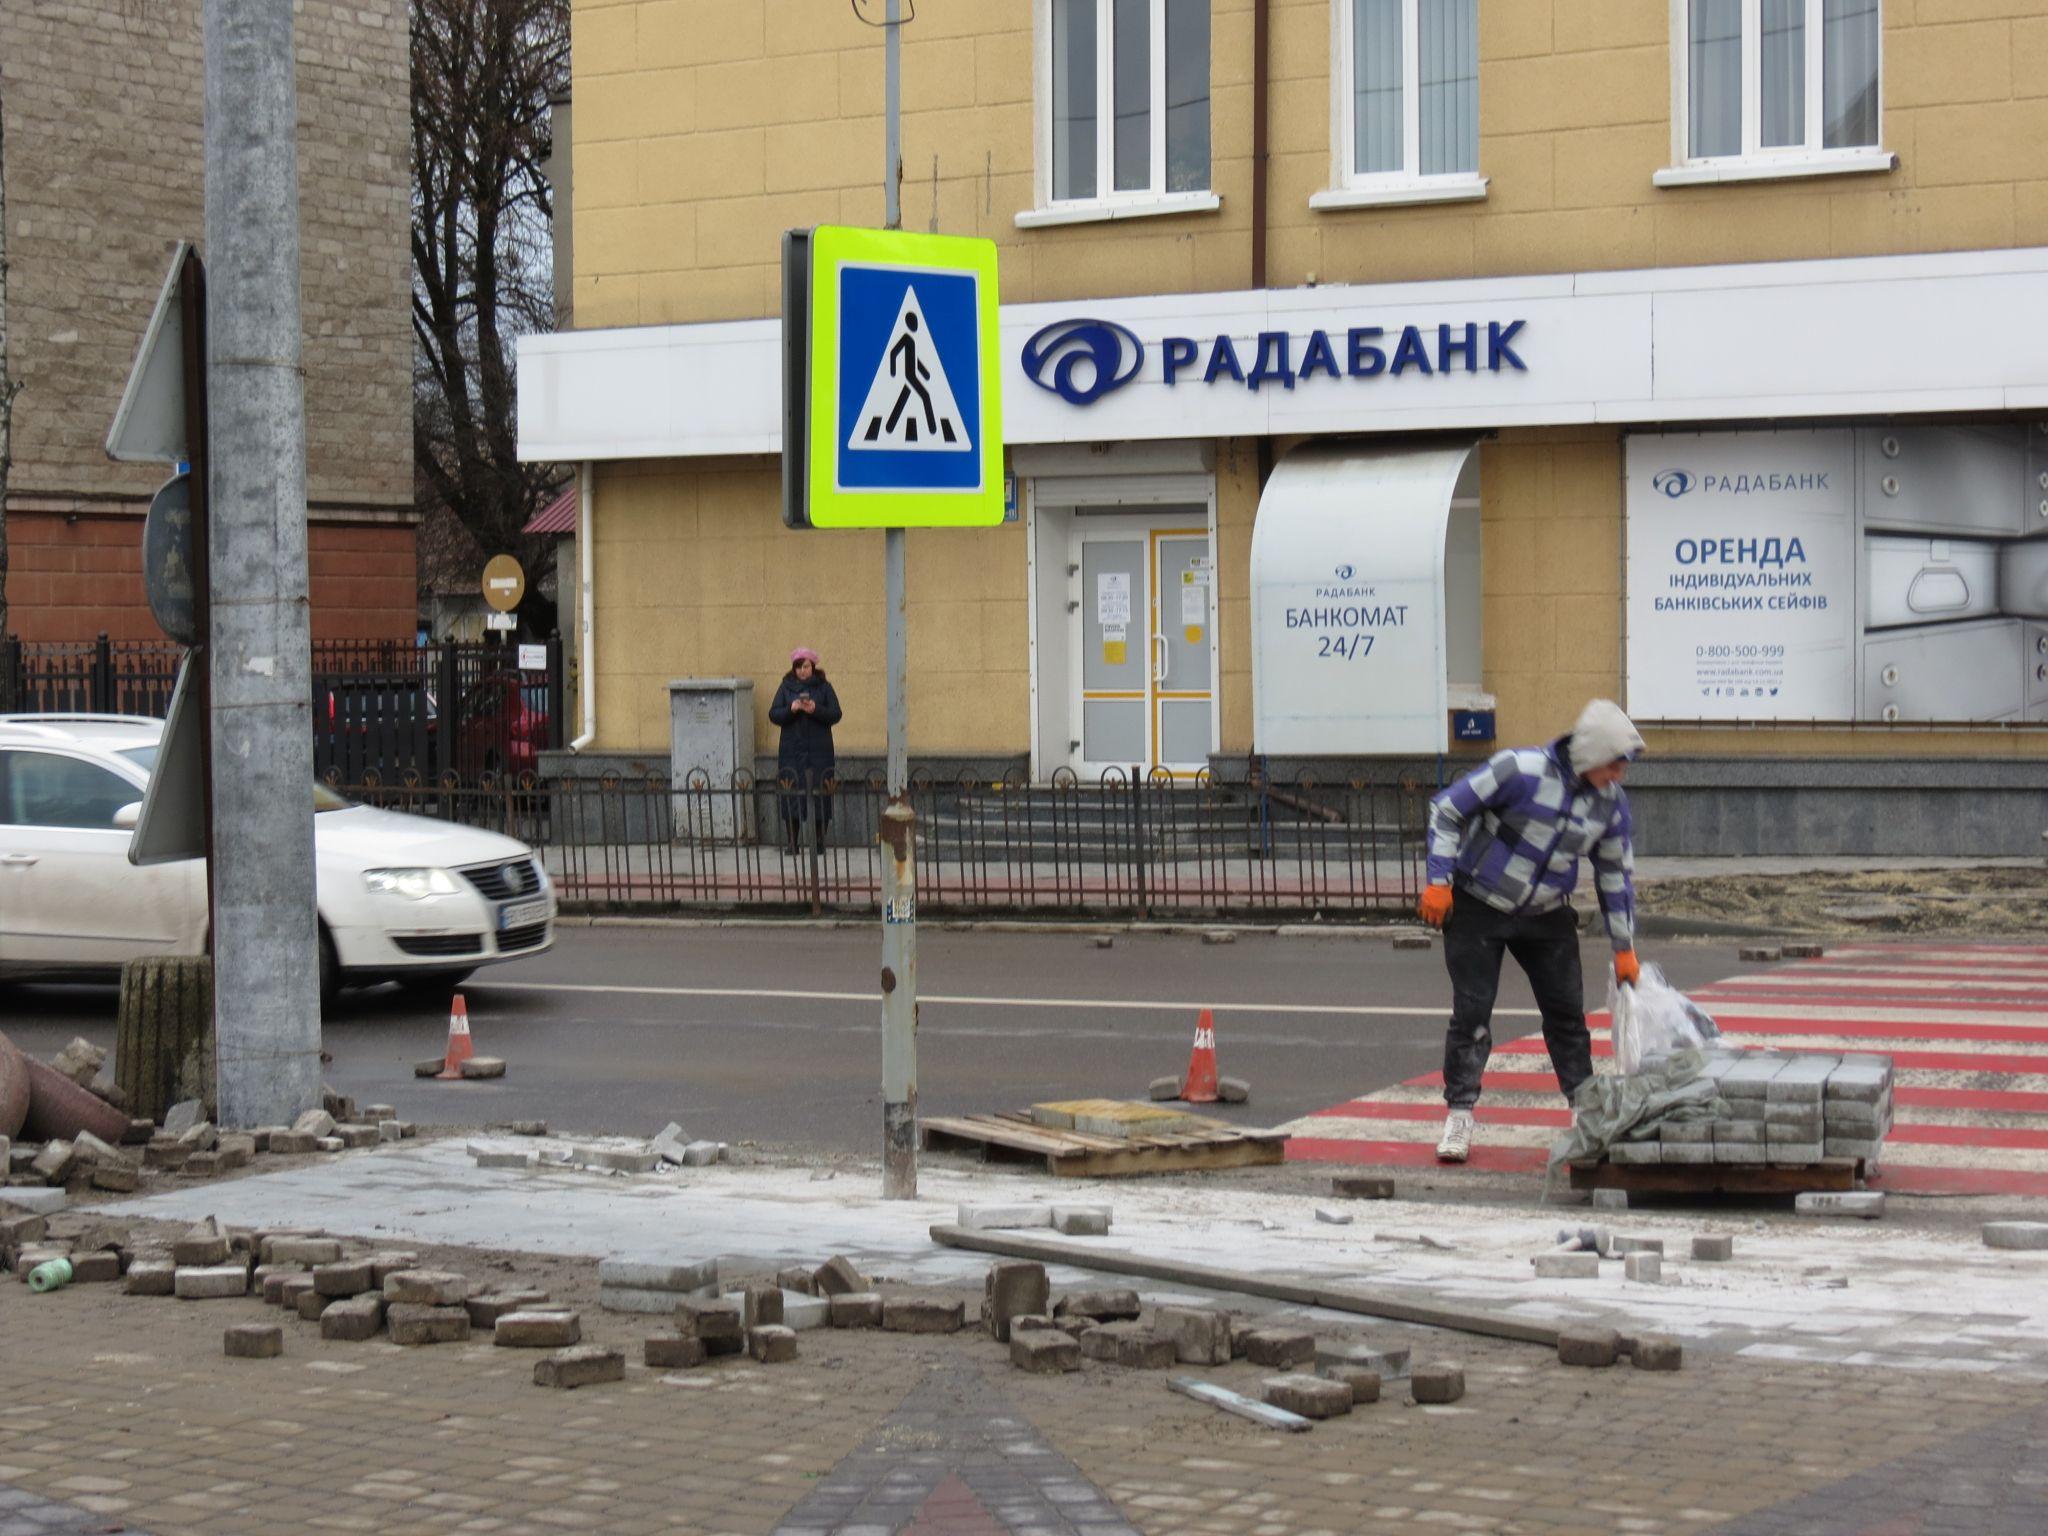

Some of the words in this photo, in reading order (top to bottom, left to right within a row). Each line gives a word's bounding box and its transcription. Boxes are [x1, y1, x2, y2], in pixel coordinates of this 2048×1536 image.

[1162, 320, 1527, 390] РАДАБАНК
[1704, 472, 1829, 494] РАДАБАНК
[1675, 537, 1806, 569] ОРЕНДА
[1669, 572, 1812, 590] ІНДИВІДУАЛЬНИХ
[1316, 587, 1376, 598] РАДАБАНК
[1655, 596, 1763, 611] БАНКІВСЬКИХ
[1768, 593, 1828, 610] СЕЙФІВ
[1286, 606, 1408, 628] БАНКОМАТ
[1318, 634, 1375, 660] 24/7
[1696, 645, 1784, 657] 0-800-500-999
